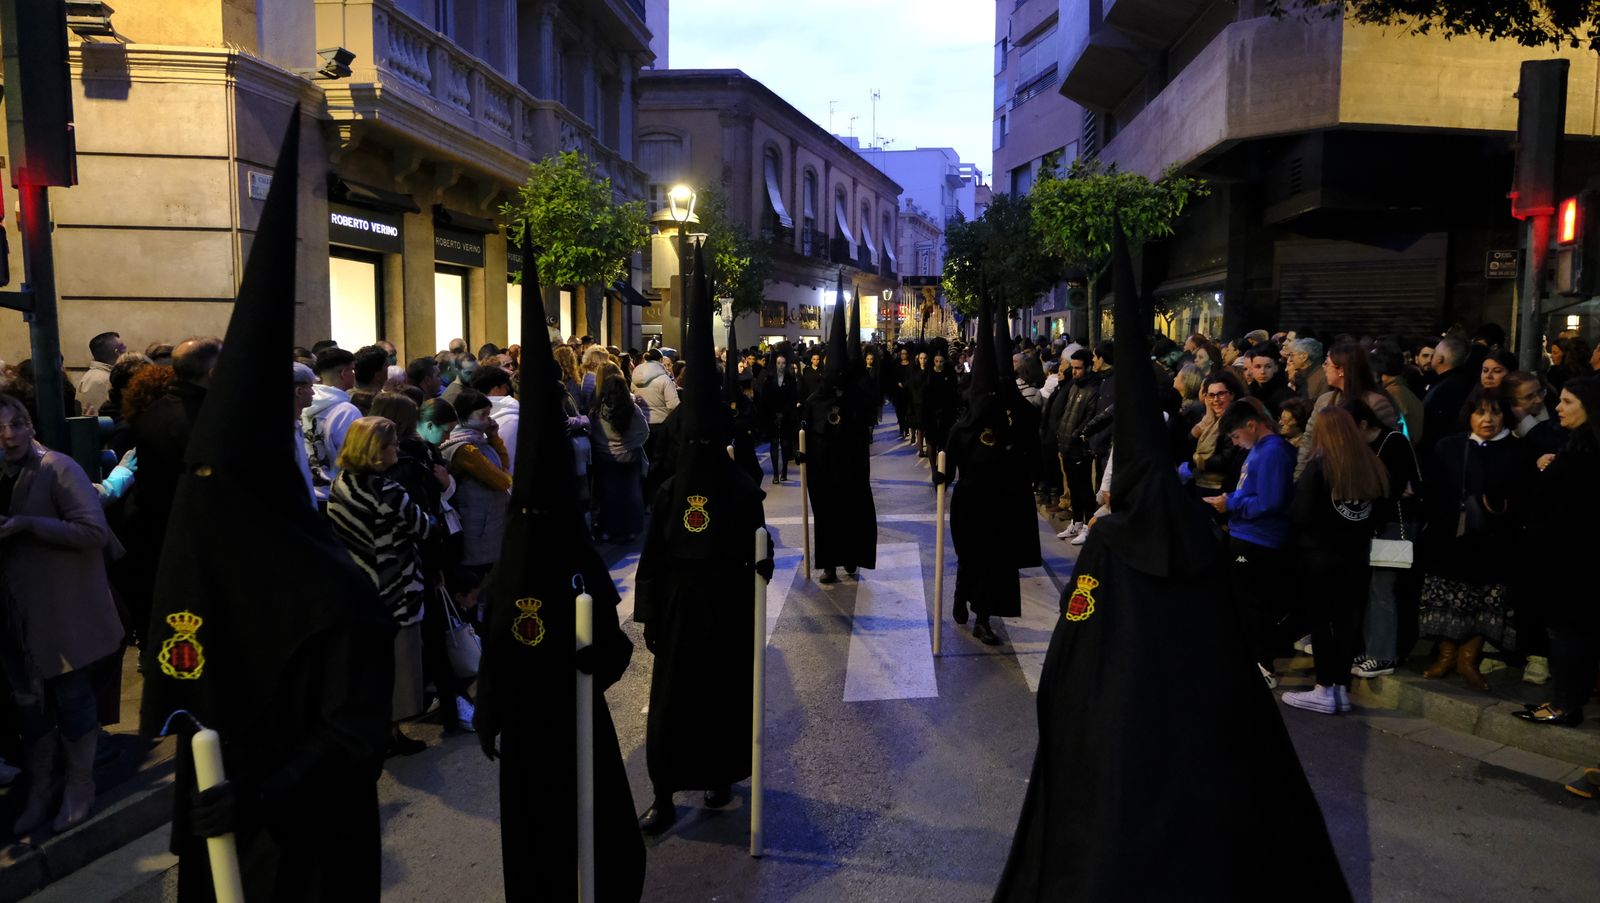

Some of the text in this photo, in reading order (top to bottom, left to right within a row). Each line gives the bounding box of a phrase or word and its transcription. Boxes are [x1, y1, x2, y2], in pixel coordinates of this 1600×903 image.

[331, 213, 398, 236] ROBERTO VERINO
[435, 237, 481, 254] ROBERTO VERINO
